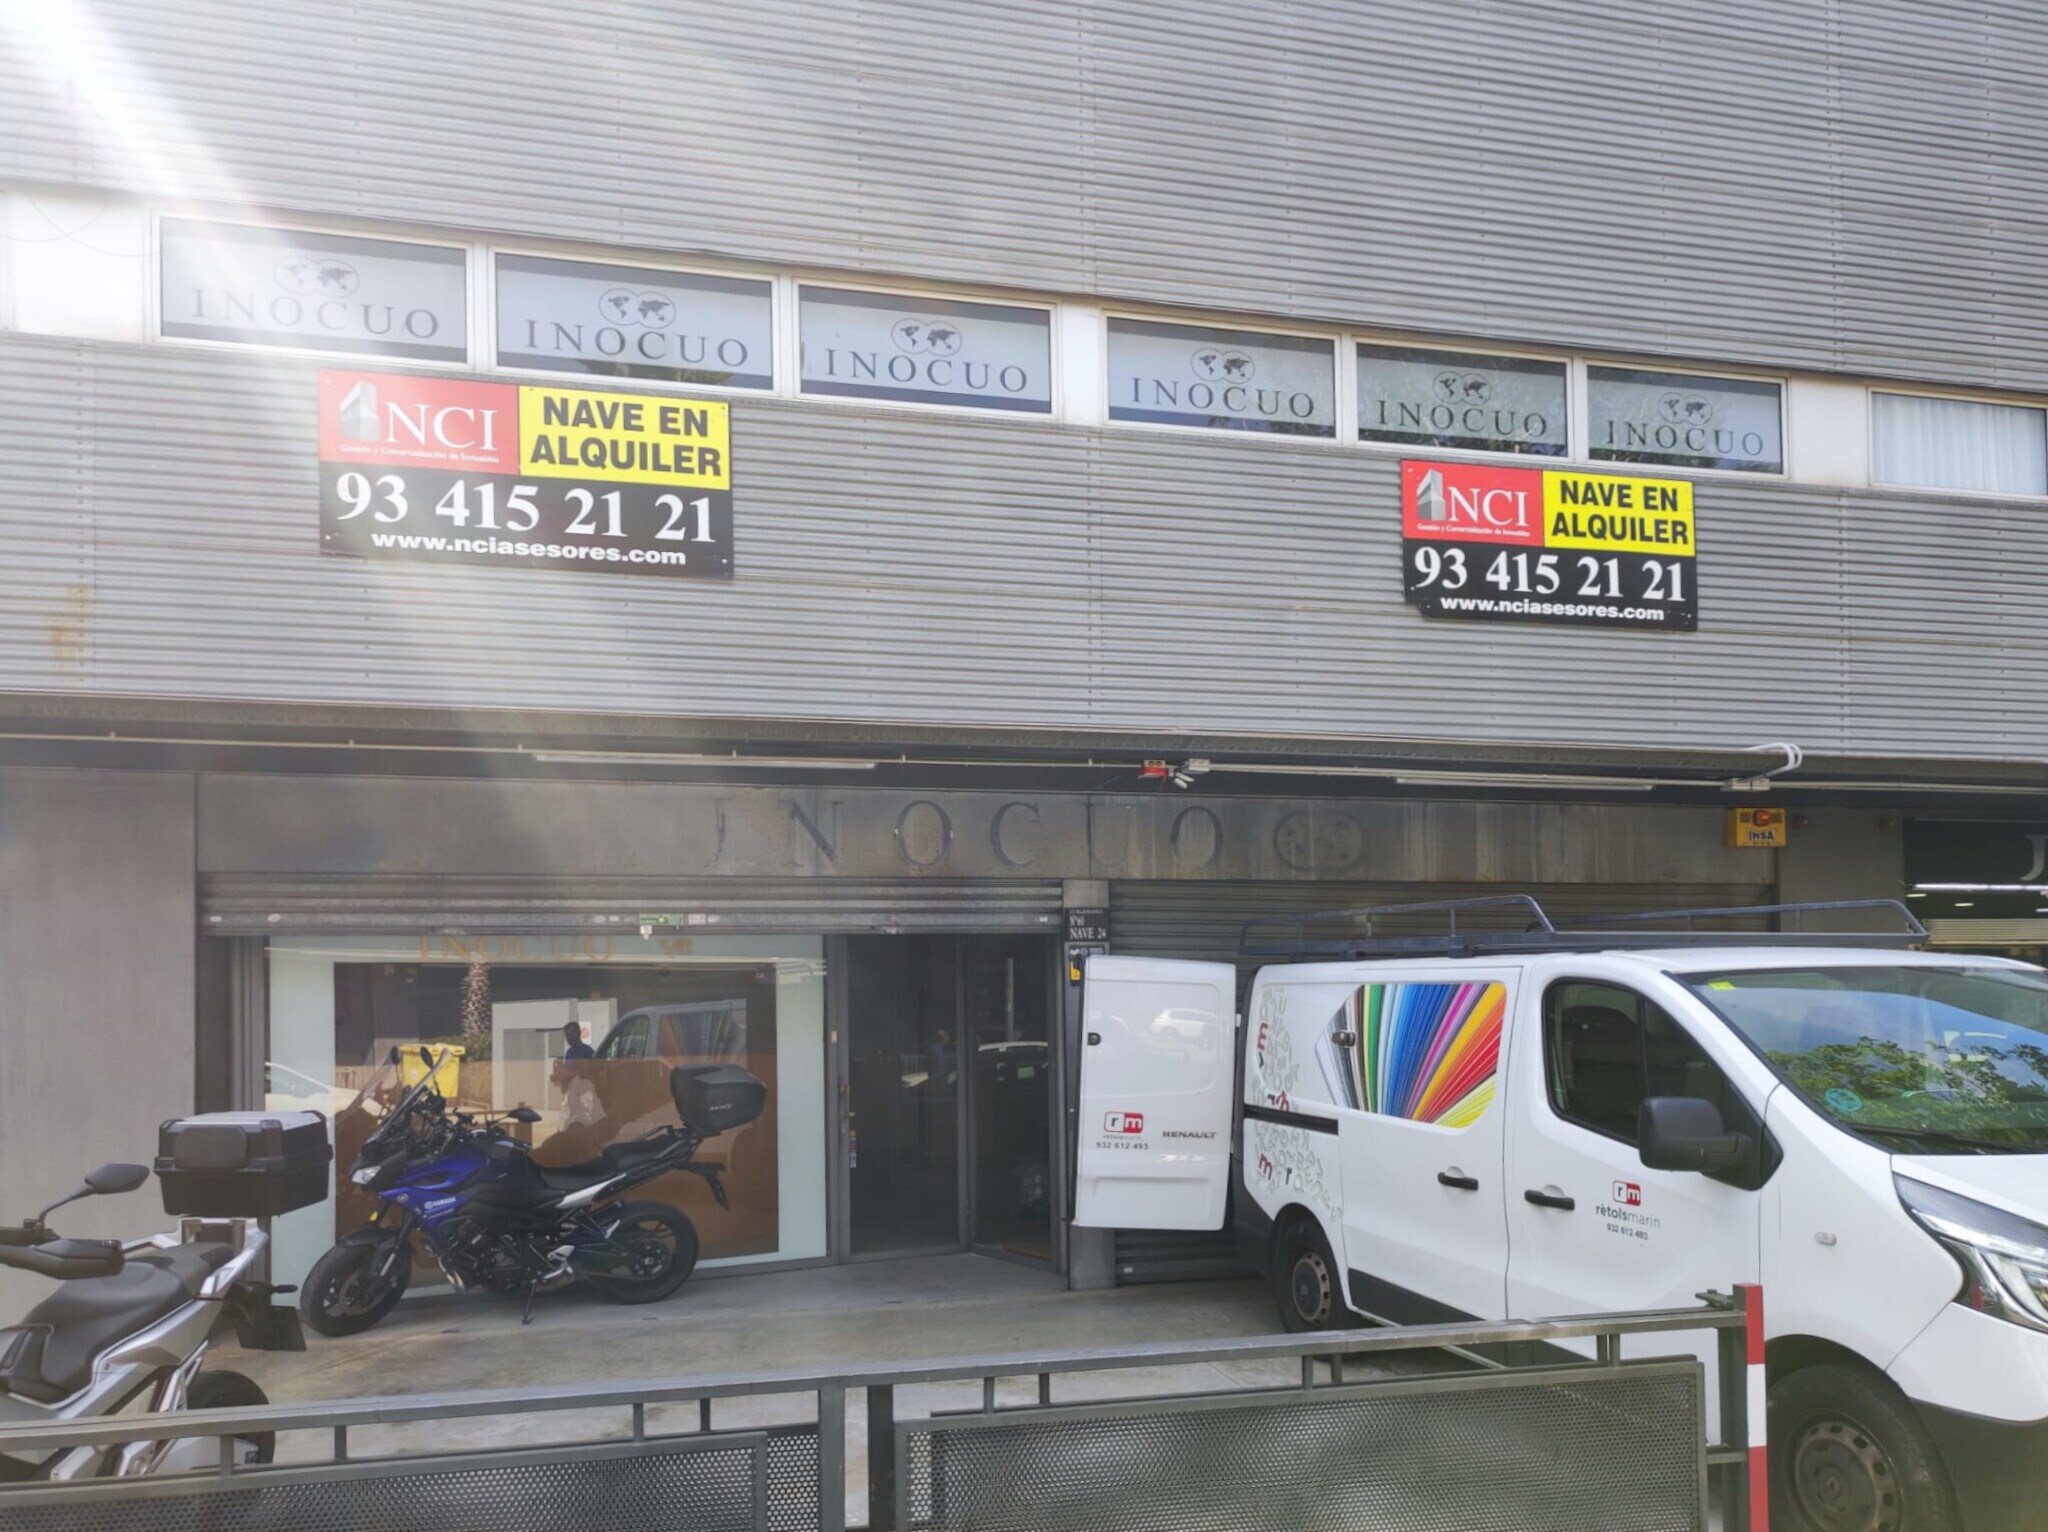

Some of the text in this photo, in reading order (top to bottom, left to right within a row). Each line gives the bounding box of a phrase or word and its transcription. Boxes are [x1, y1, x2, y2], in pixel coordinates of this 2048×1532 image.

[192, 287, 438, 339] INOCUO
[525, 319, 748, 367] INOCUO
[824, 348, 1027, 393] INOCUO
[543, 396, 708, 437] NAVE EN
[1131, 377, 1315, 418] INOCUO
[384, 401, 499, 451] NCI
[1377, 400, 1547, 438] INOCUO
[1606, 420, 1763, 456] INOCUO
[530, 434, 722, 477] ALQUILER
[336, 472, 717, 543] 93 415 21 21
[1447, 486, 1530, 527] NCI
[1560, 480, 1678, 512] NAVE EN
[1552, 512, 1689, 545] ALQUILER
[372, 533, 687, 565] www.nciasesores.com
[1414, 546, 1686, 602] 93 415 21 21
[1440, 597, 1664, 621] www.nciasesores.com
[1749, 831, 1774, 841] INSA
[1069, 927, 1106, 939] NAVE 24
[1132, 1142, 1149, 1150] 493
[1162, 1131, 1217, 1139] RENAULT
